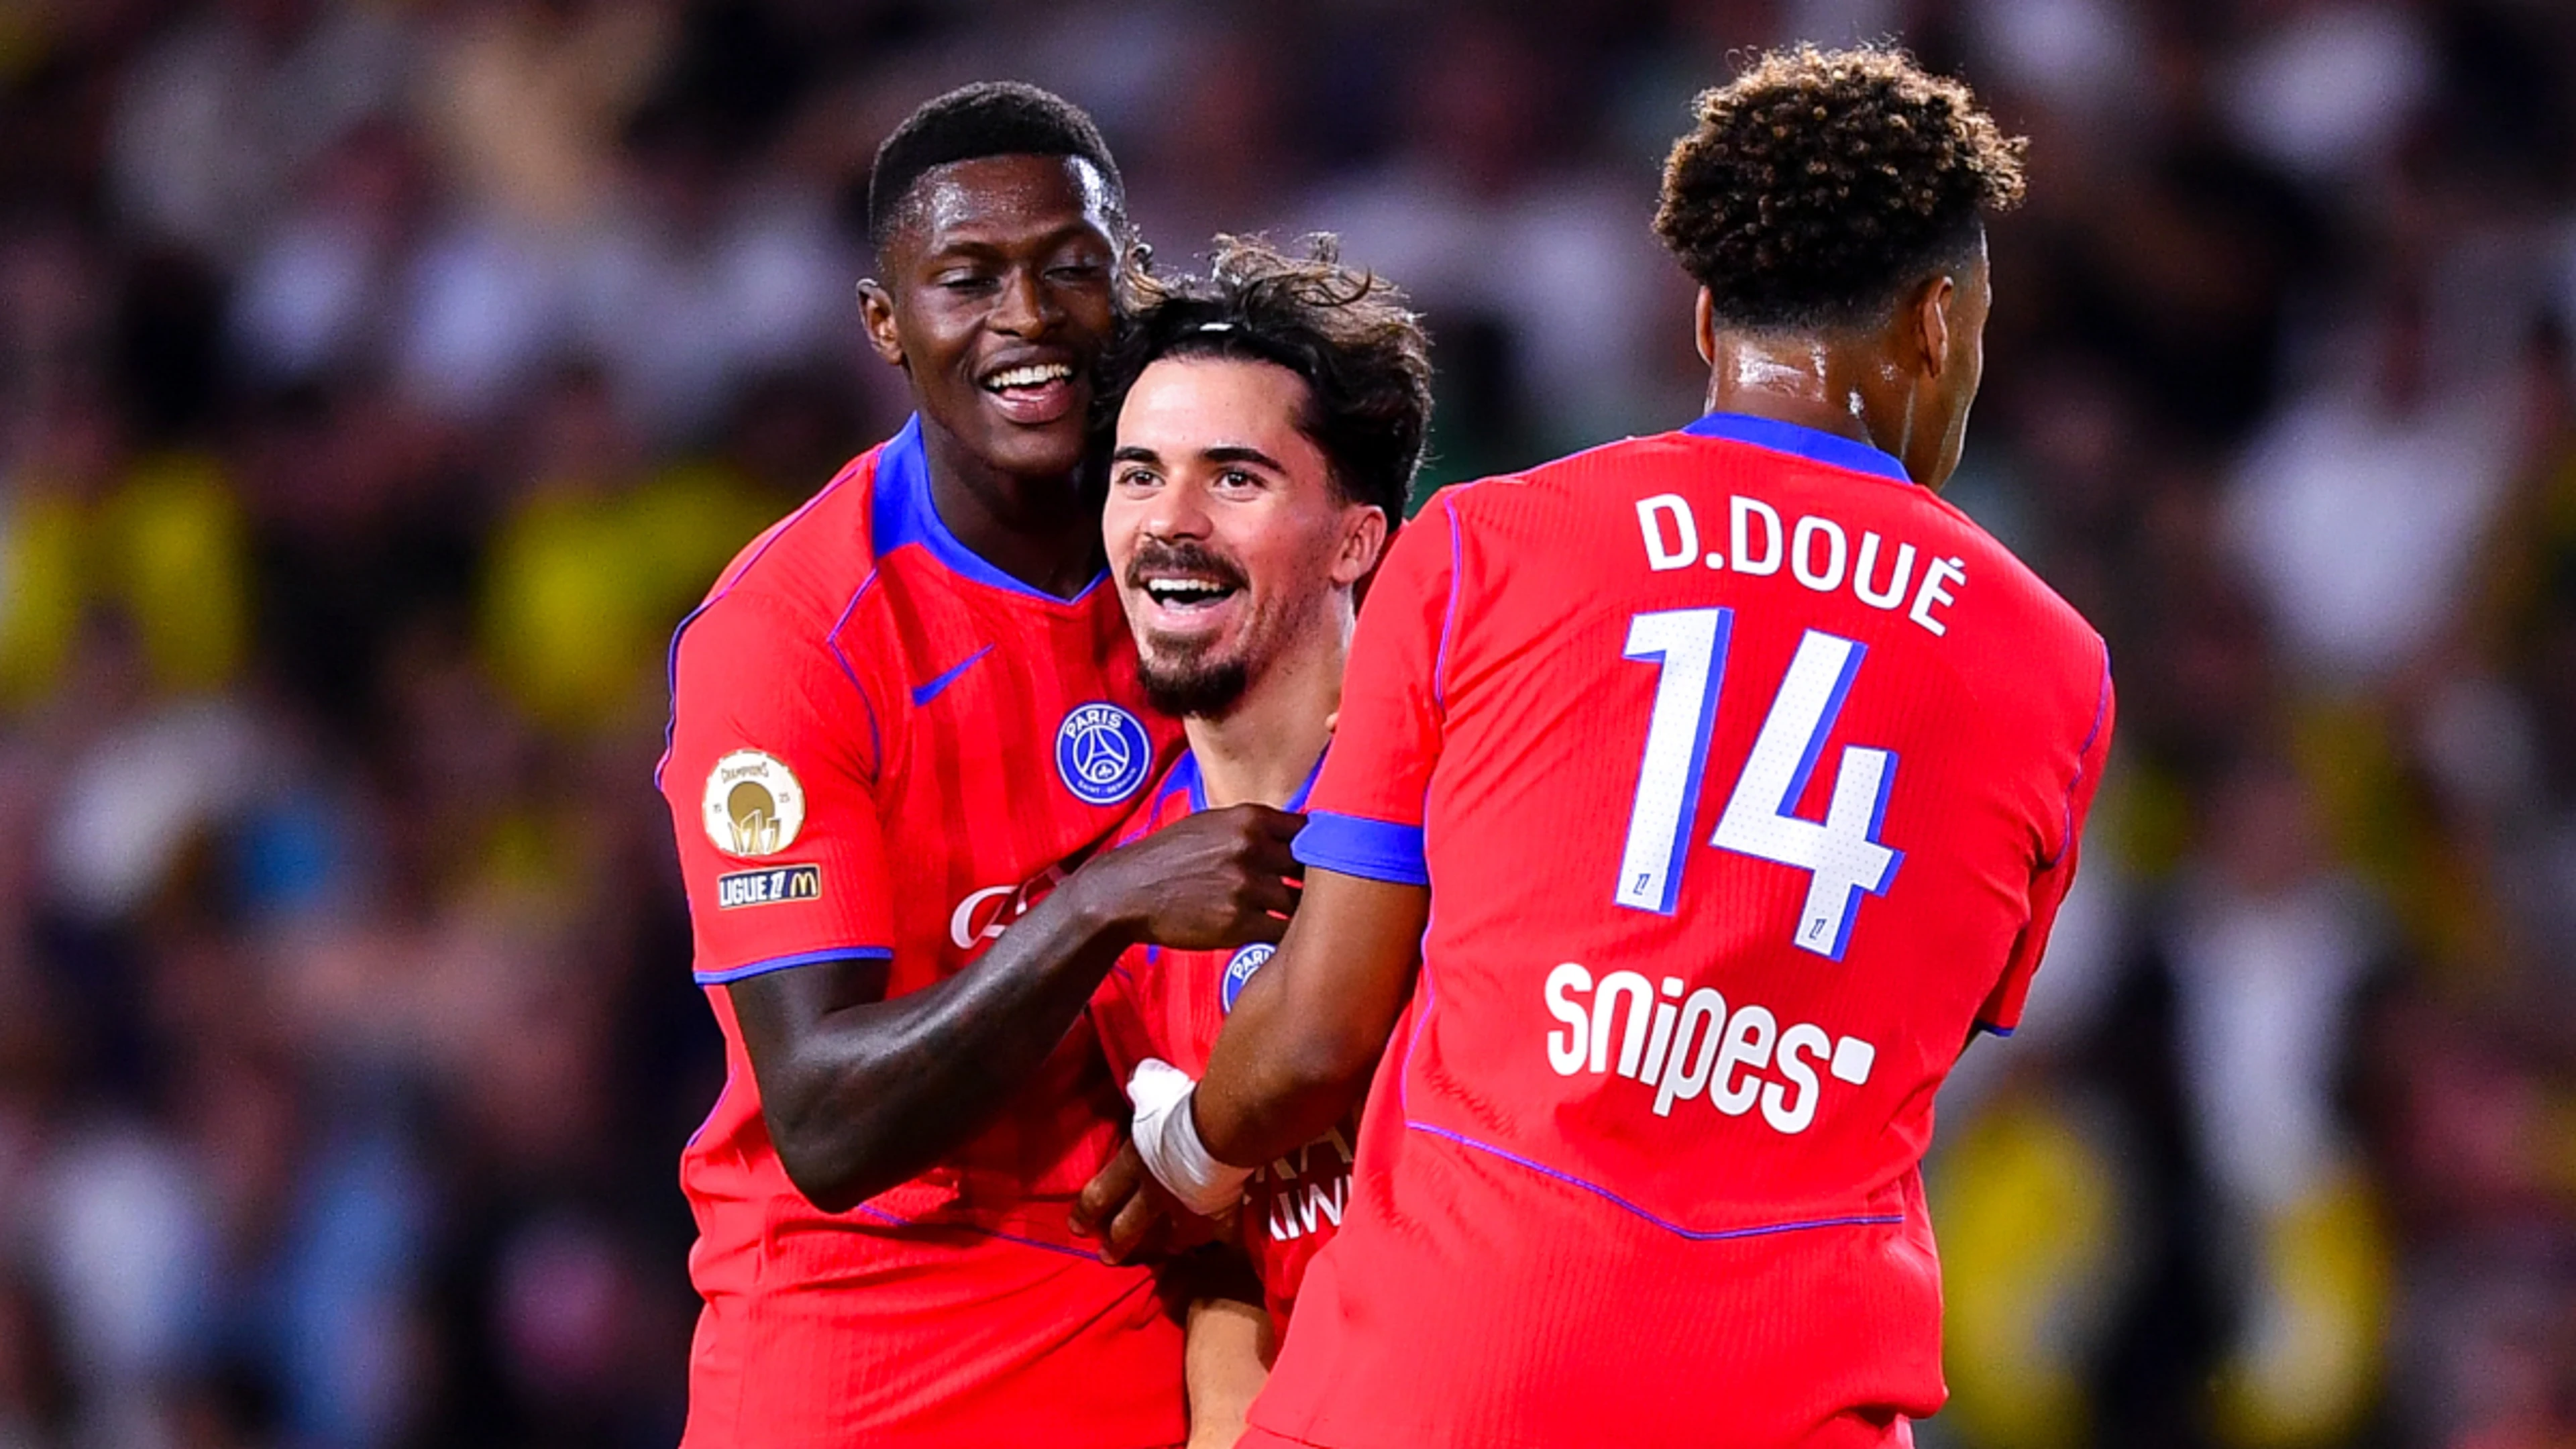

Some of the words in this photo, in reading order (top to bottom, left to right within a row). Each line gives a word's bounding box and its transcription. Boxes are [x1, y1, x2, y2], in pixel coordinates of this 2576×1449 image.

[1635, 493, 1966, 637] D.DOUÉ
[1065, 710, 1123, 739] PARIS
[1613, 605, 1906, 962] 14
[720, 874, 767, 906] LIGUE
[1232, 950, 1270, 979] PARI
[1544, 962, 1831, 1134] snipes
